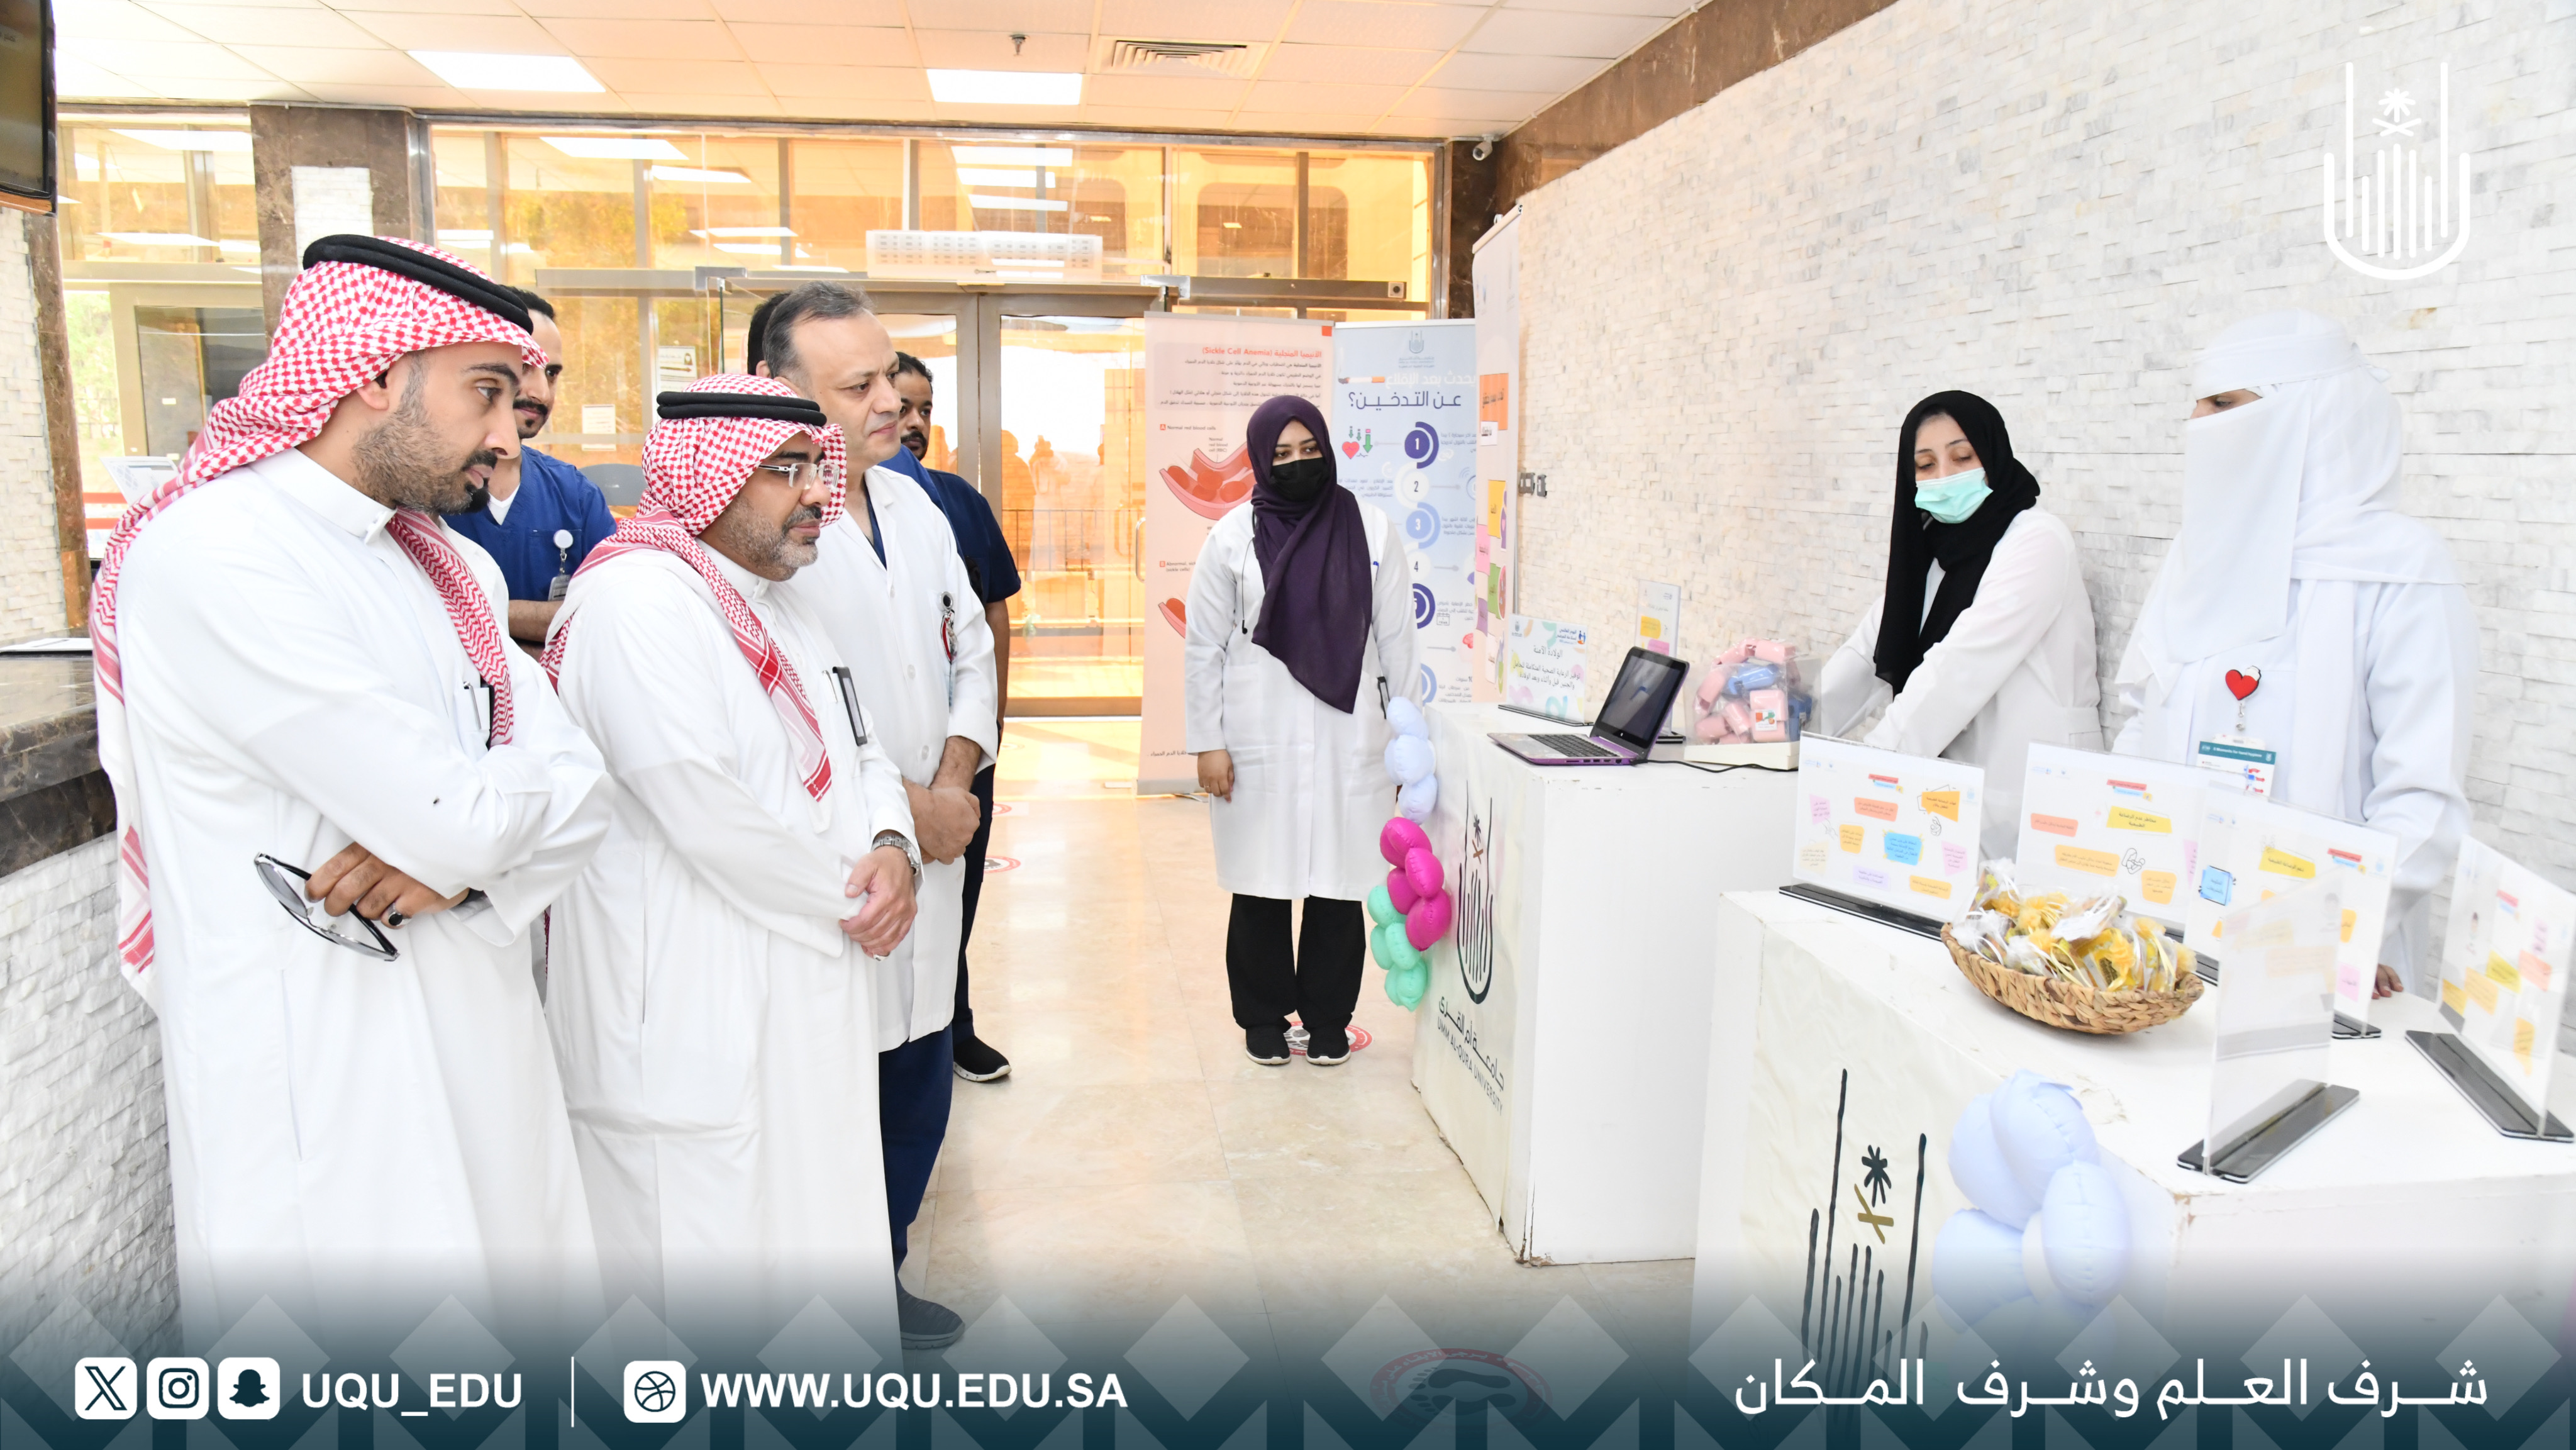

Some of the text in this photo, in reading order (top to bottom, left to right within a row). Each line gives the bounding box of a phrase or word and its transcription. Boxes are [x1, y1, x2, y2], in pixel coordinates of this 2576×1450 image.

[1243, 349, 1272, 357] Anemia)
[1433, 391, 1461, 409] عن
[1414, 481, 1419, 493] 2
[1416, 518, 1421, 531] 3
[1414, 561, 1419, 572] 4
[1438, 996, 1504, 1092] جامعة أم القرى
[1437, 1016, 1503, 1117] UMM AL-QURA UNIVERSITY
